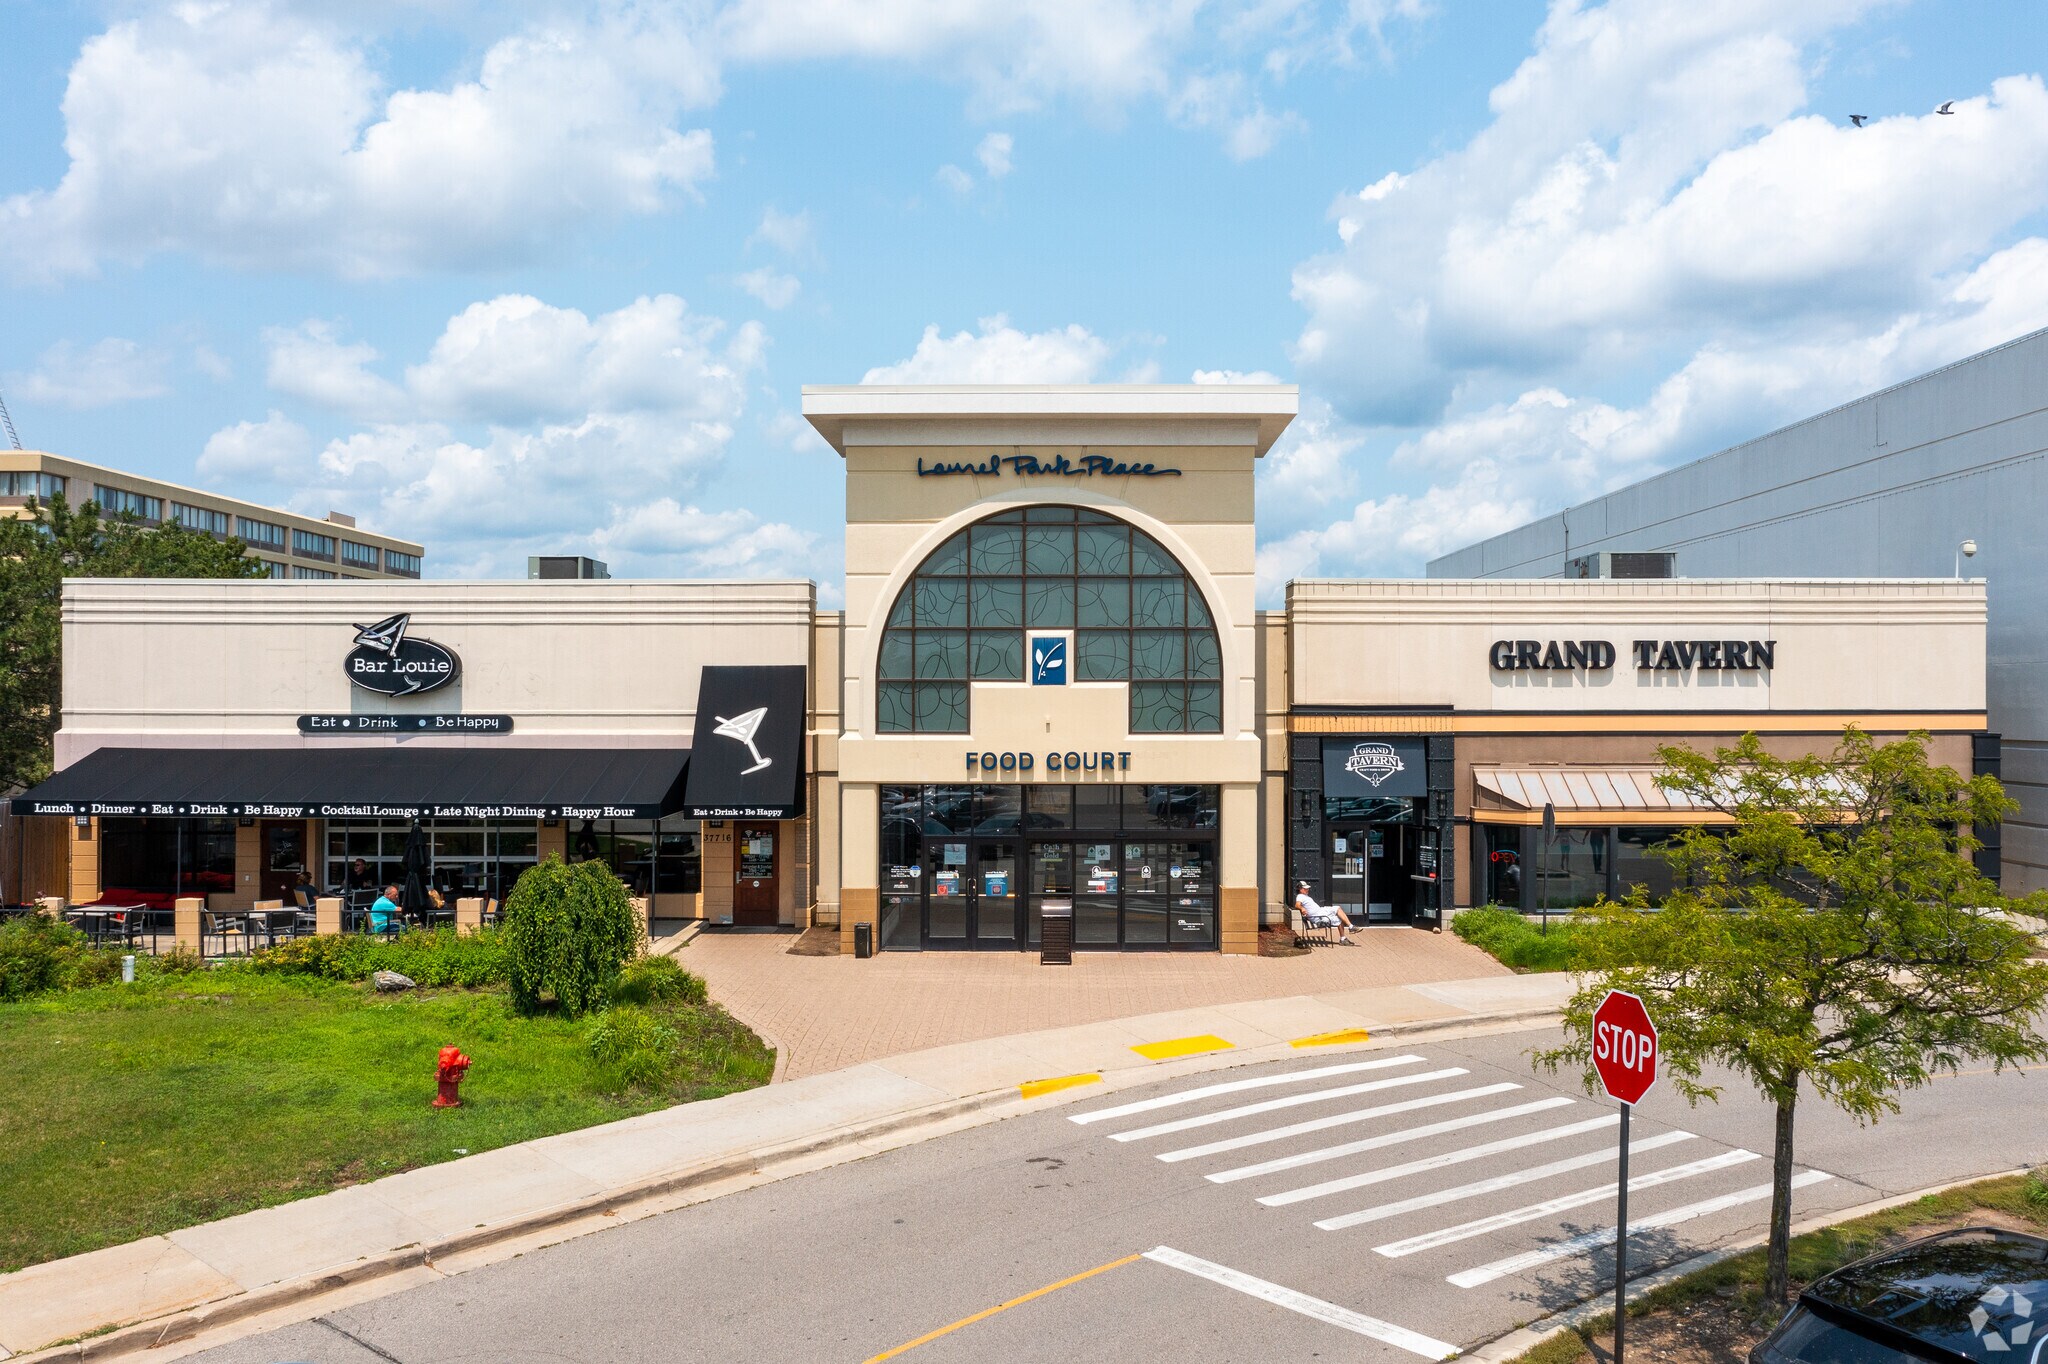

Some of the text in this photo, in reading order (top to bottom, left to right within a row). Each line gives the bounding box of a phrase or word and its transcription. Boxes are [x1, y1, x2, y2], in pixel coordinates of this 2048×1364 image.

[918, 454, 1181, 476] Laurel Park Place
[1489, 640, 1777, 671] GRAND TAVERN
[353, 658, 449, 673] Bar Louie
[311, 716, 499, 729] Eat Drink Be Happy
[1359, 746, 1389, 755] GRAND
[966, 751, 1132, 771] FOOD COURT
[1351, 756, 1397, 767] TAVERN
[34, 803, 635, 819] Lunch Dinner Eat Drink Be Happy Cocktail Lounge Late Night Dining Happy Hour
[693, 808, 783, 817] Eat Drink Be Happy
[703, 833, 732, 842] 37716
[1596, 1021, 1653, 1073] STOP
